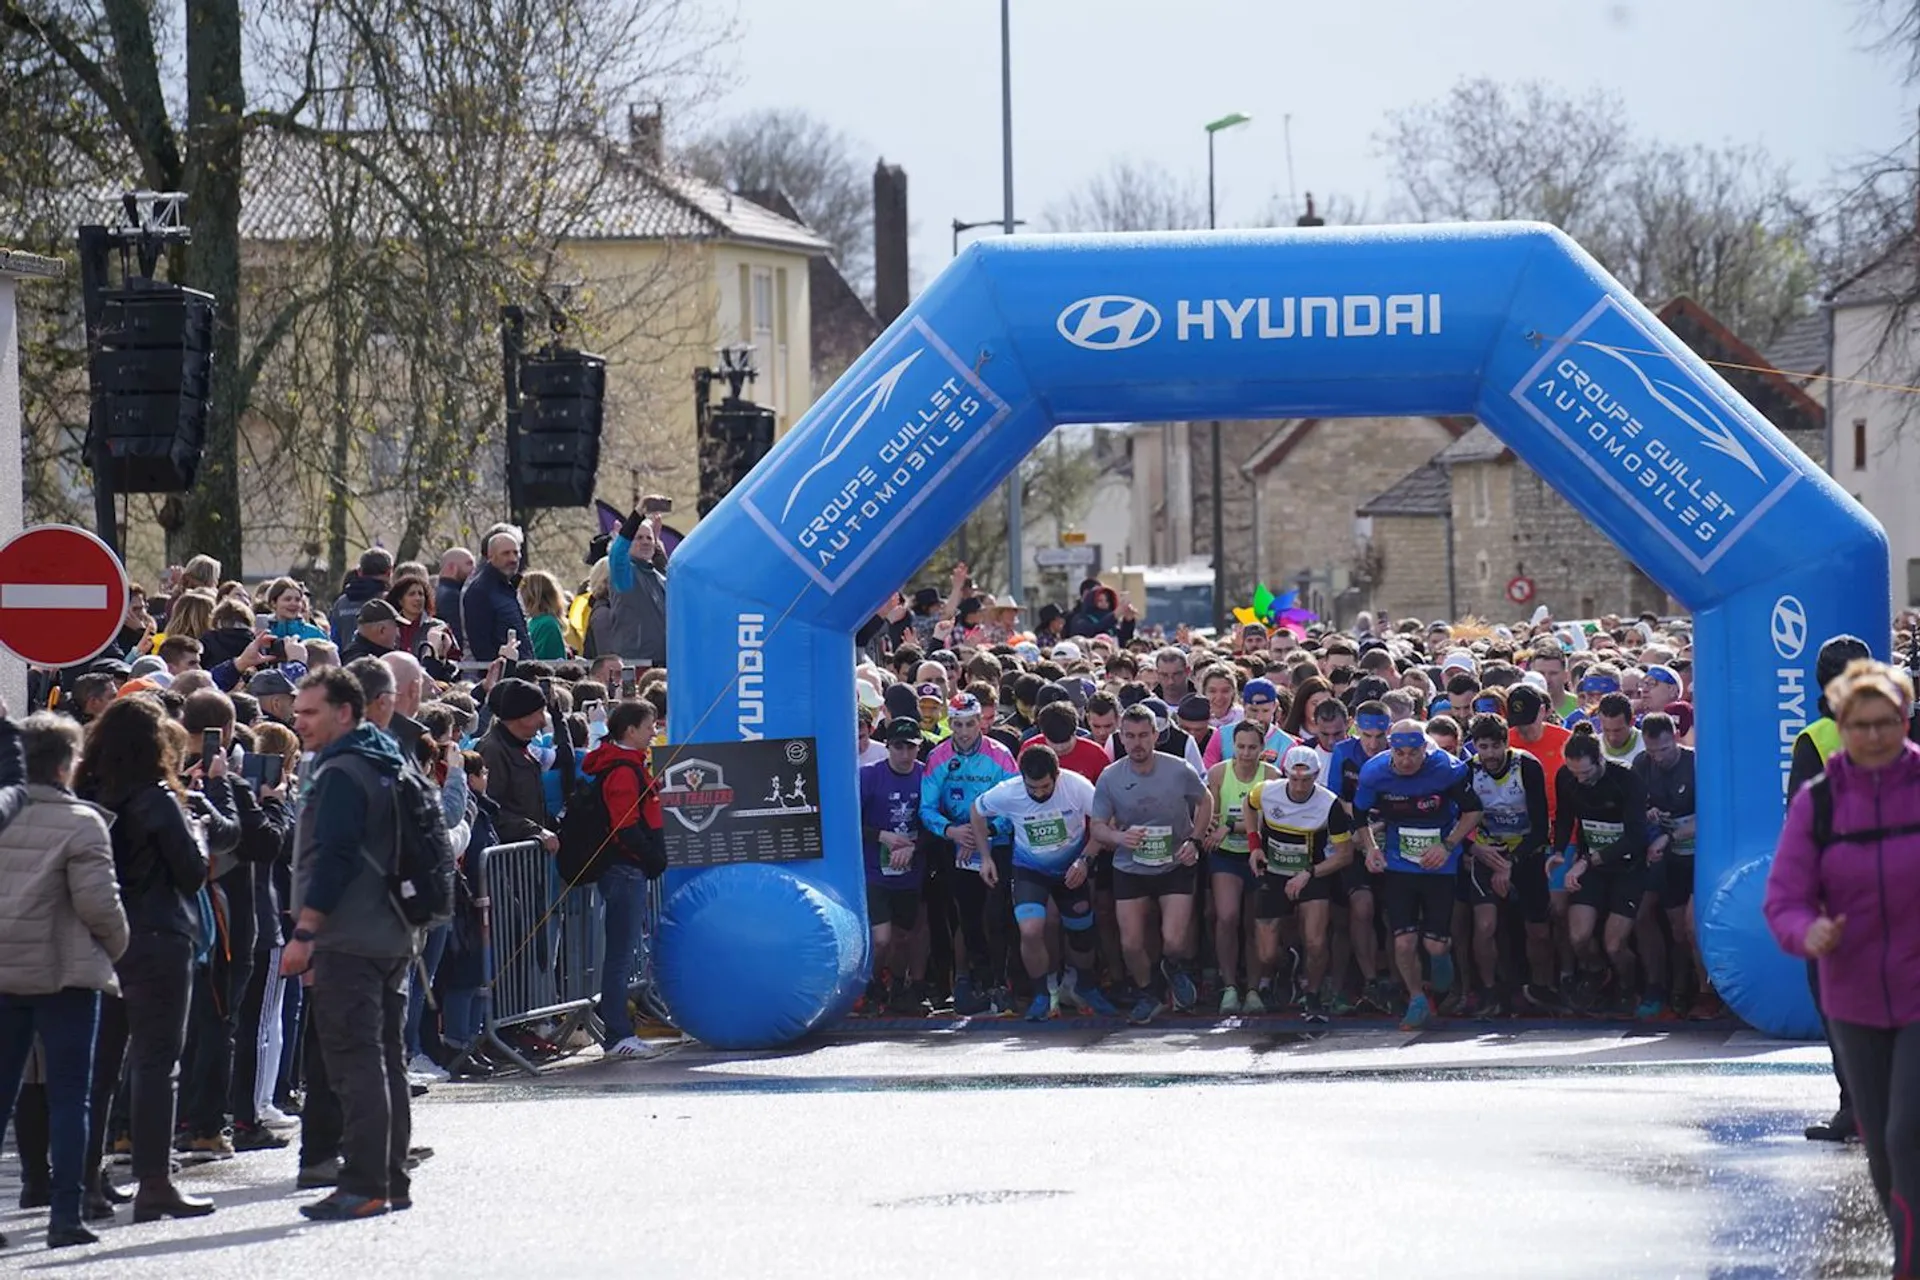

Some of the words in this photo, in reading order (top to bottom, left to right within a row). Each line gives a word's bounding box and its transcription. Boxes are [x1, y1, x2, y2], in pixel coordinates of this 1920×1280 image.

[1177, 293, 1441, 341] HYUNDAI
[798, 464, 878, 548] GROUPE
[878, 376, 962, 464] GUILLET
[817, 395, 981, 567] AUTOMOBILES
[1538, 379, 1717, 542] AUTOMOBILES
[1556, 358, 1644, 438] GROUPE
[1645, 438, 1736, 523] GUILLET
[738, 613, 765, 743] YUNDAI
[1030, 825, 1059, 837] 3075
[1406, 836, 1432, 848] 3216
